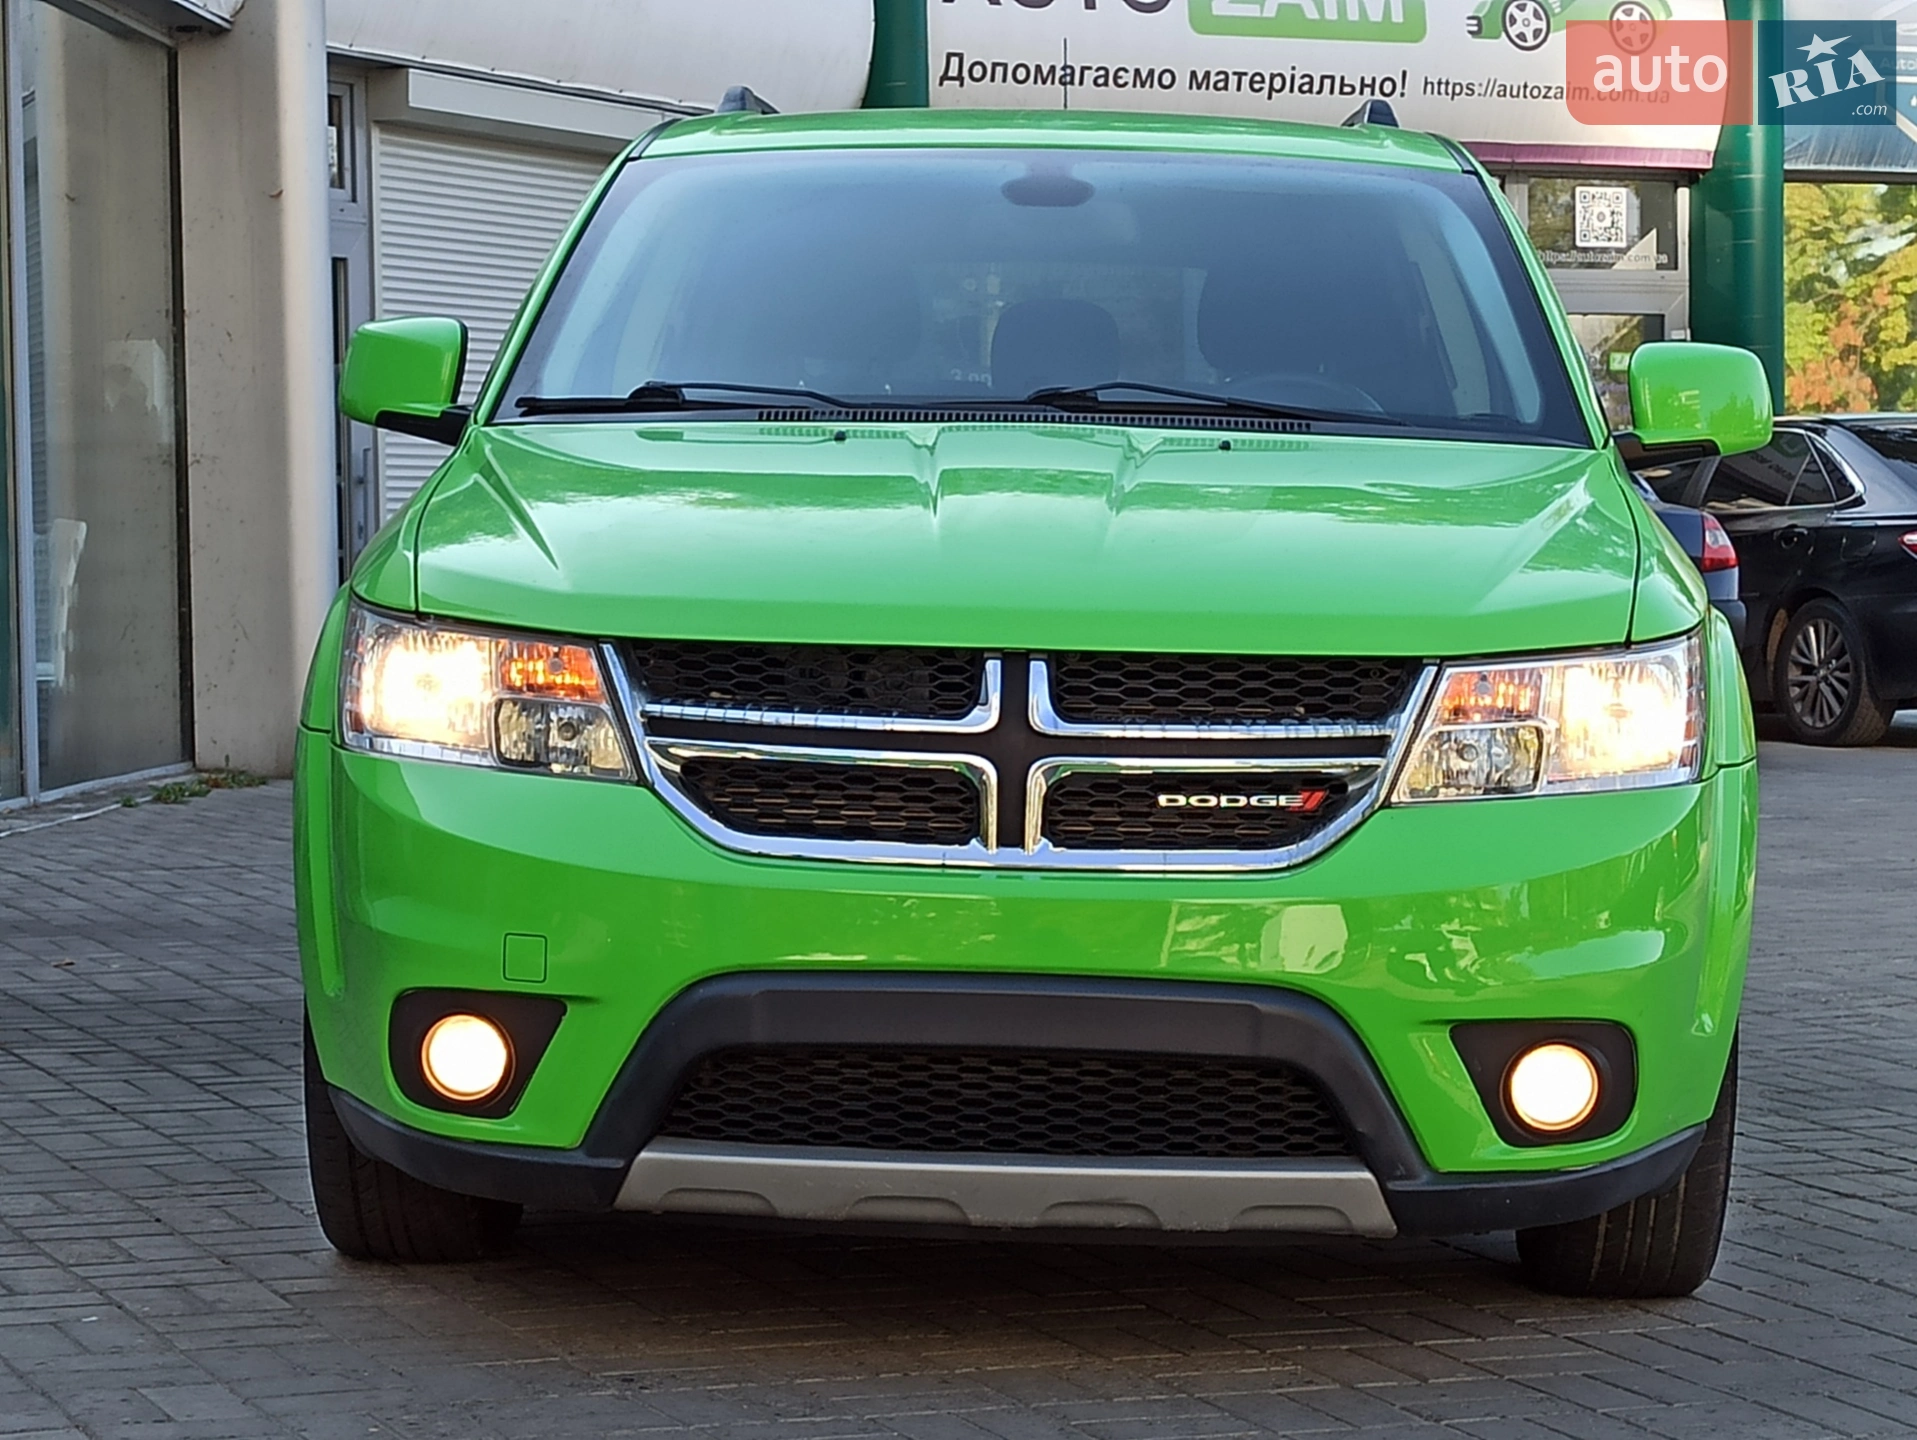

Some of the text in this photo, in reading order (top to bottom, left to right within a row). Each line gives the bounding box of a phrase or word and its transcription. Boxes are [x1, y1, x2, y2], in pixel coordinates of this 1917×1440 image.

[938, 52, 1408, 99] Допомагаємо матеріально!
[1157, 794, 1304, 807] DODGE
